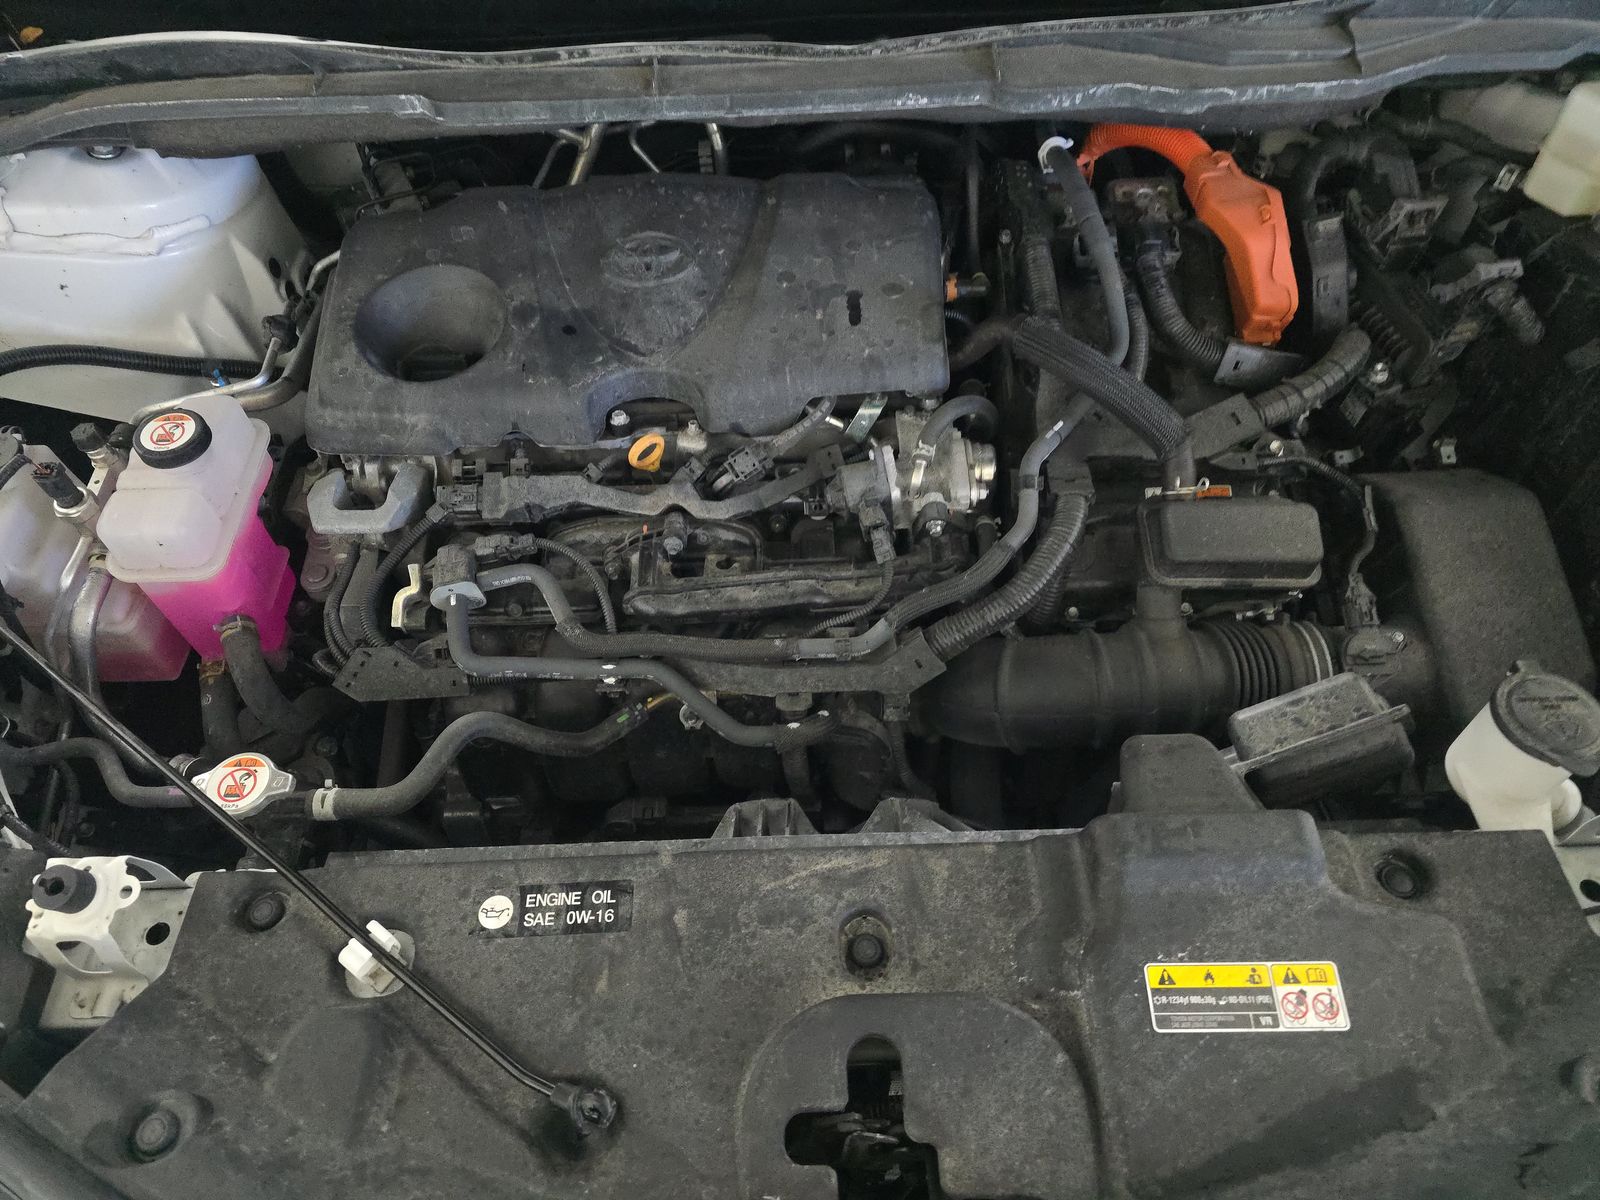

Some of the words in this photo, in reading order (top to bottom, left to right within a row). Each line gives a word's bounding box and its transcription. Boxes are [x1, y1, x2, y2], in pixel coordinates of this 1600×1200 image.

[525, 891, 582, 908] ENGINE
[591, 889, 616, 904] OIL
[523, 911, 556, 927] SAE
[566, 908, 615, 925] 0W-16
